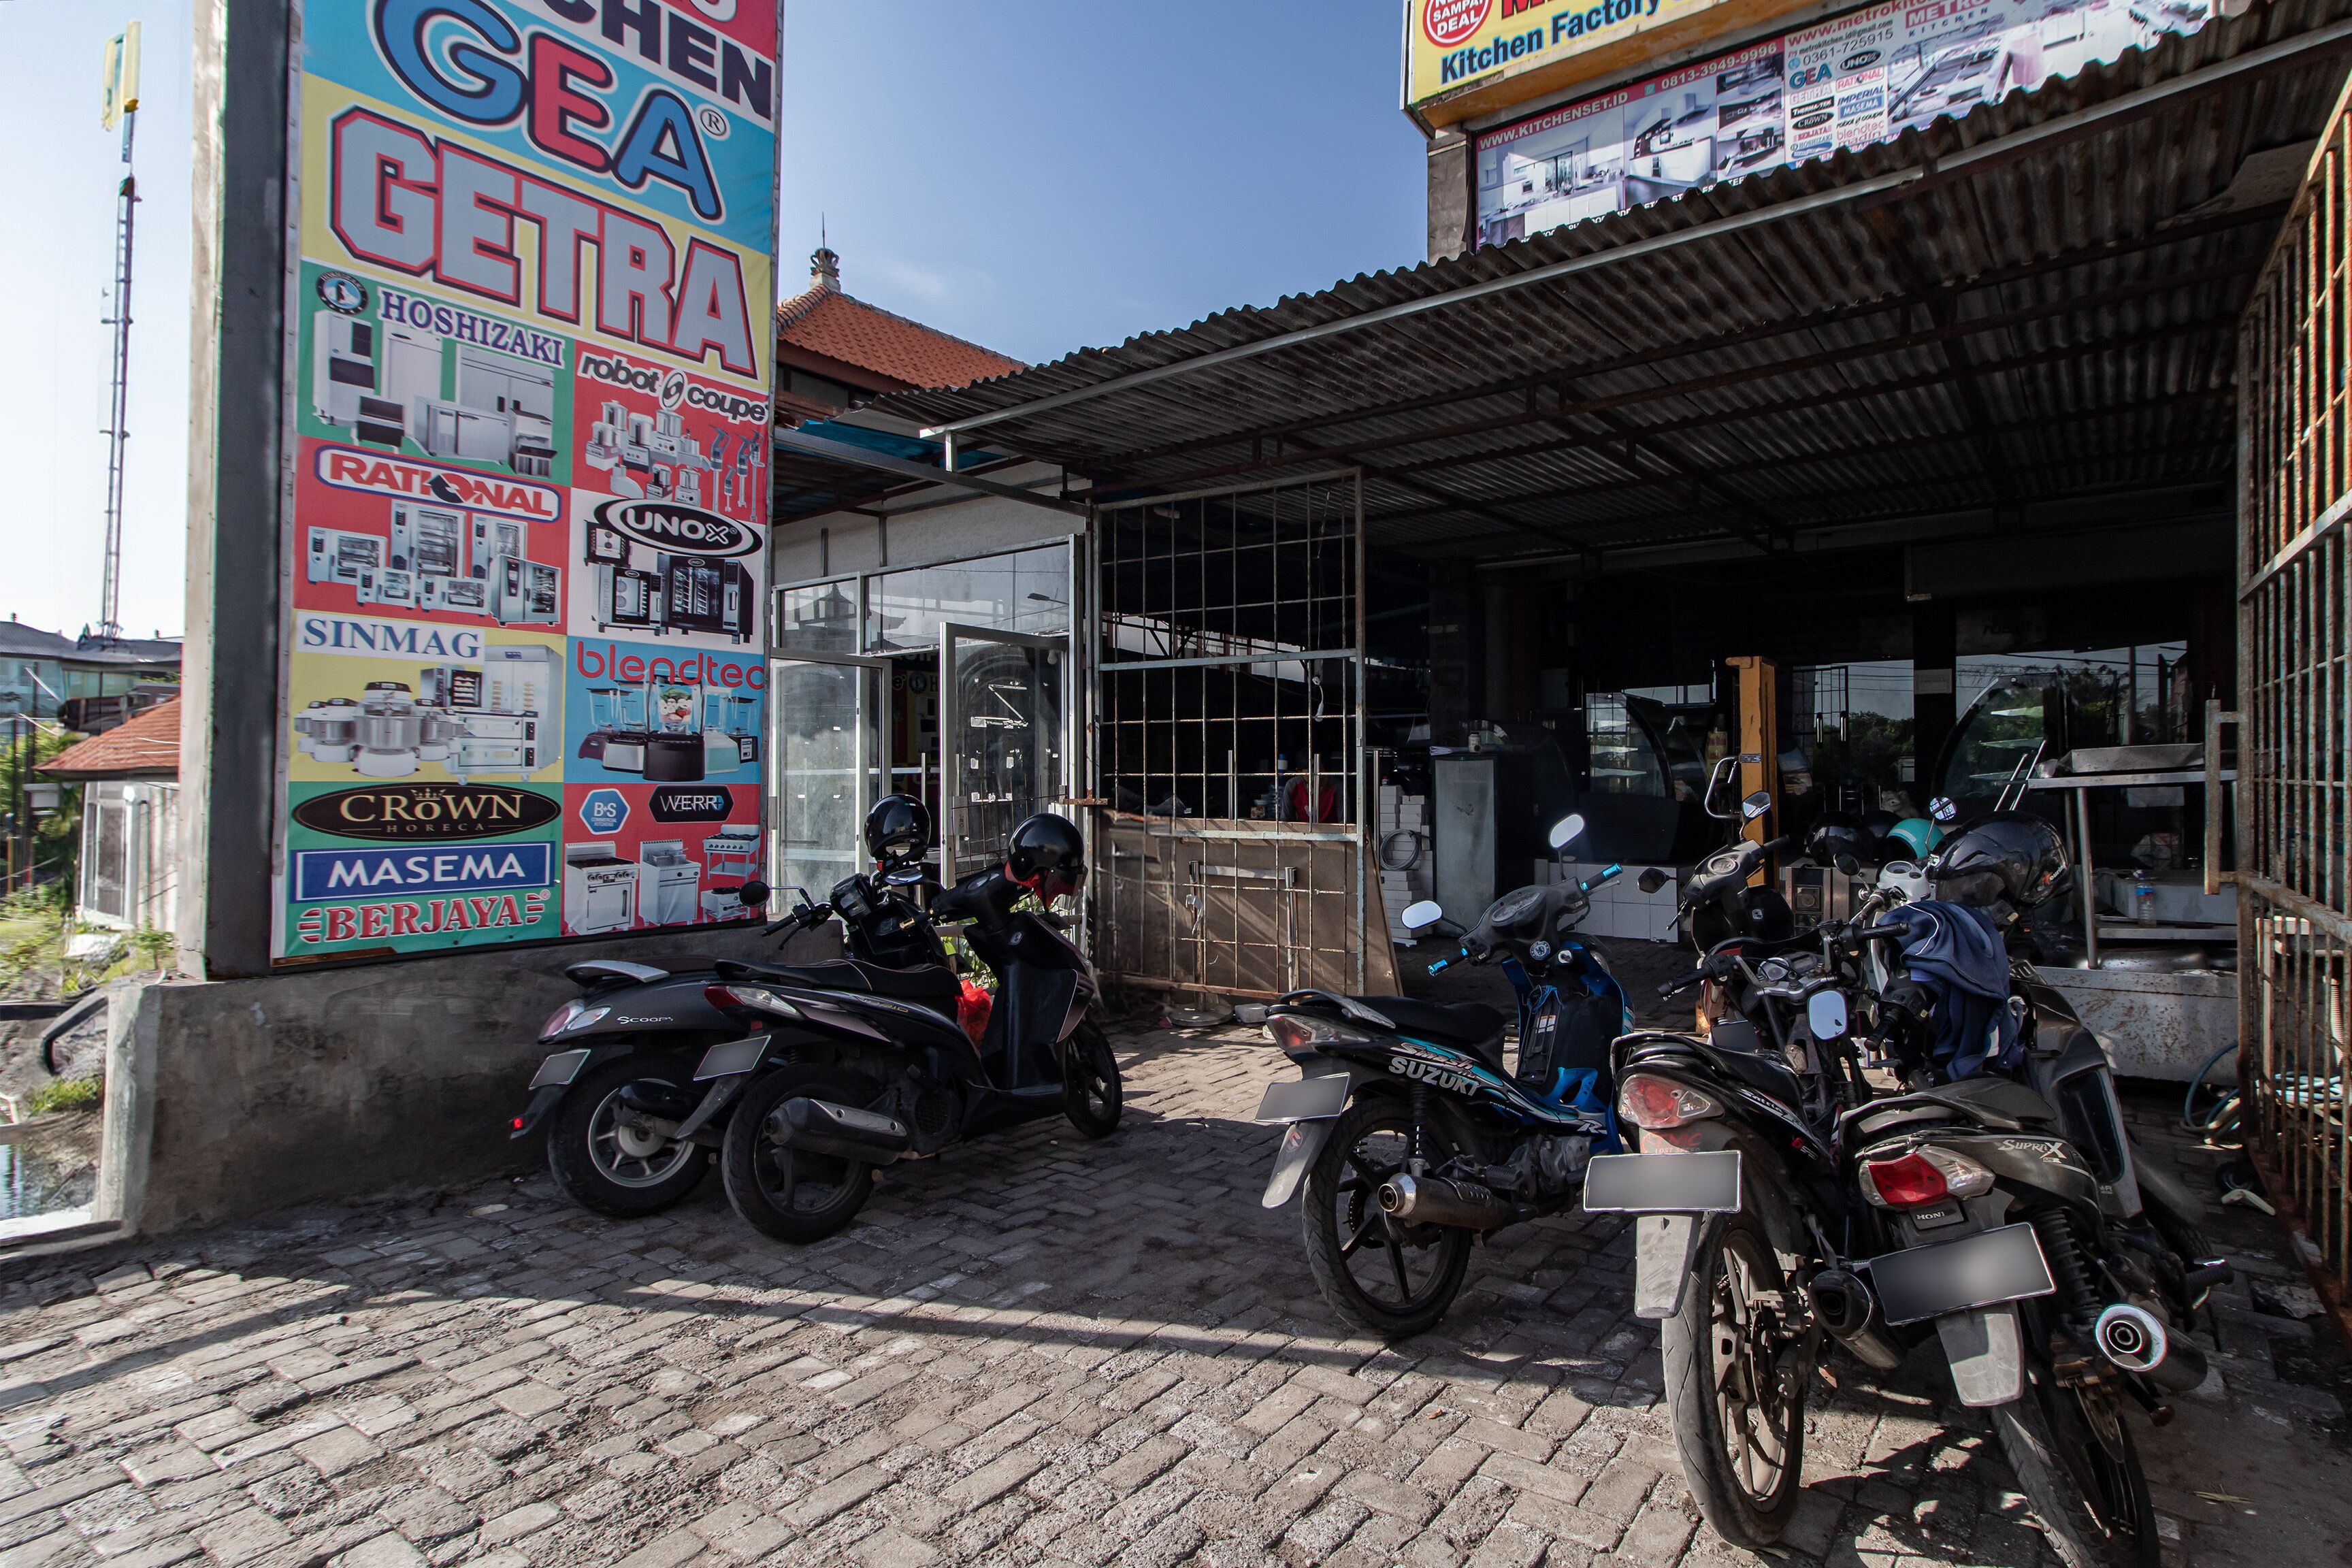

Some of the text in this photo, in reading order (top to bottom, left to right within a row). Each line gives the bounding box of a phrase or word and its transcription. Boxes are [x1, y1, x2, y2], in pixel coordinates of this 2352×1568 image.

[1437, 10, 1480, 36] DEAL
[1909, 7, 1988, 37] KITCHEN
[1441, 0, 1659, 84] Kitchen Factory
[1803, 28, 1894, 66] 0361-725915
[1842, 52, 1877, 69] UNOX
[1661, 42, 1778, 90] 0813-3949-9996
[1789, 63, 1832, 88] GEA
[1838, 85, 1884, 105] IMPERIAL
[1843, 98, 1878, 116] MASEMA
[1480, 92, 1629, 150] WWW.KITCHENSET.ID
[1837, 120, 1884, 140] blendtec
[329, 106, 758, 381] GETRA
[381, 291, 563, 366] HOSHIZAKI
[581, 356, 766, 421] robot coupe
[626, 508, 730, 544] UNOX
[304, 619, 480, 660] SINMAG
[576, 640, 765, 690] blendtec
[387, 823, 484, 833] HORECA
[593, 802, 617, 817] B+S
[328, 852, 525, 887] MASEMA
[325, 894, 524, 943] BERJAYA
[1388, 1057, 1480, 1096] SUZUKI
